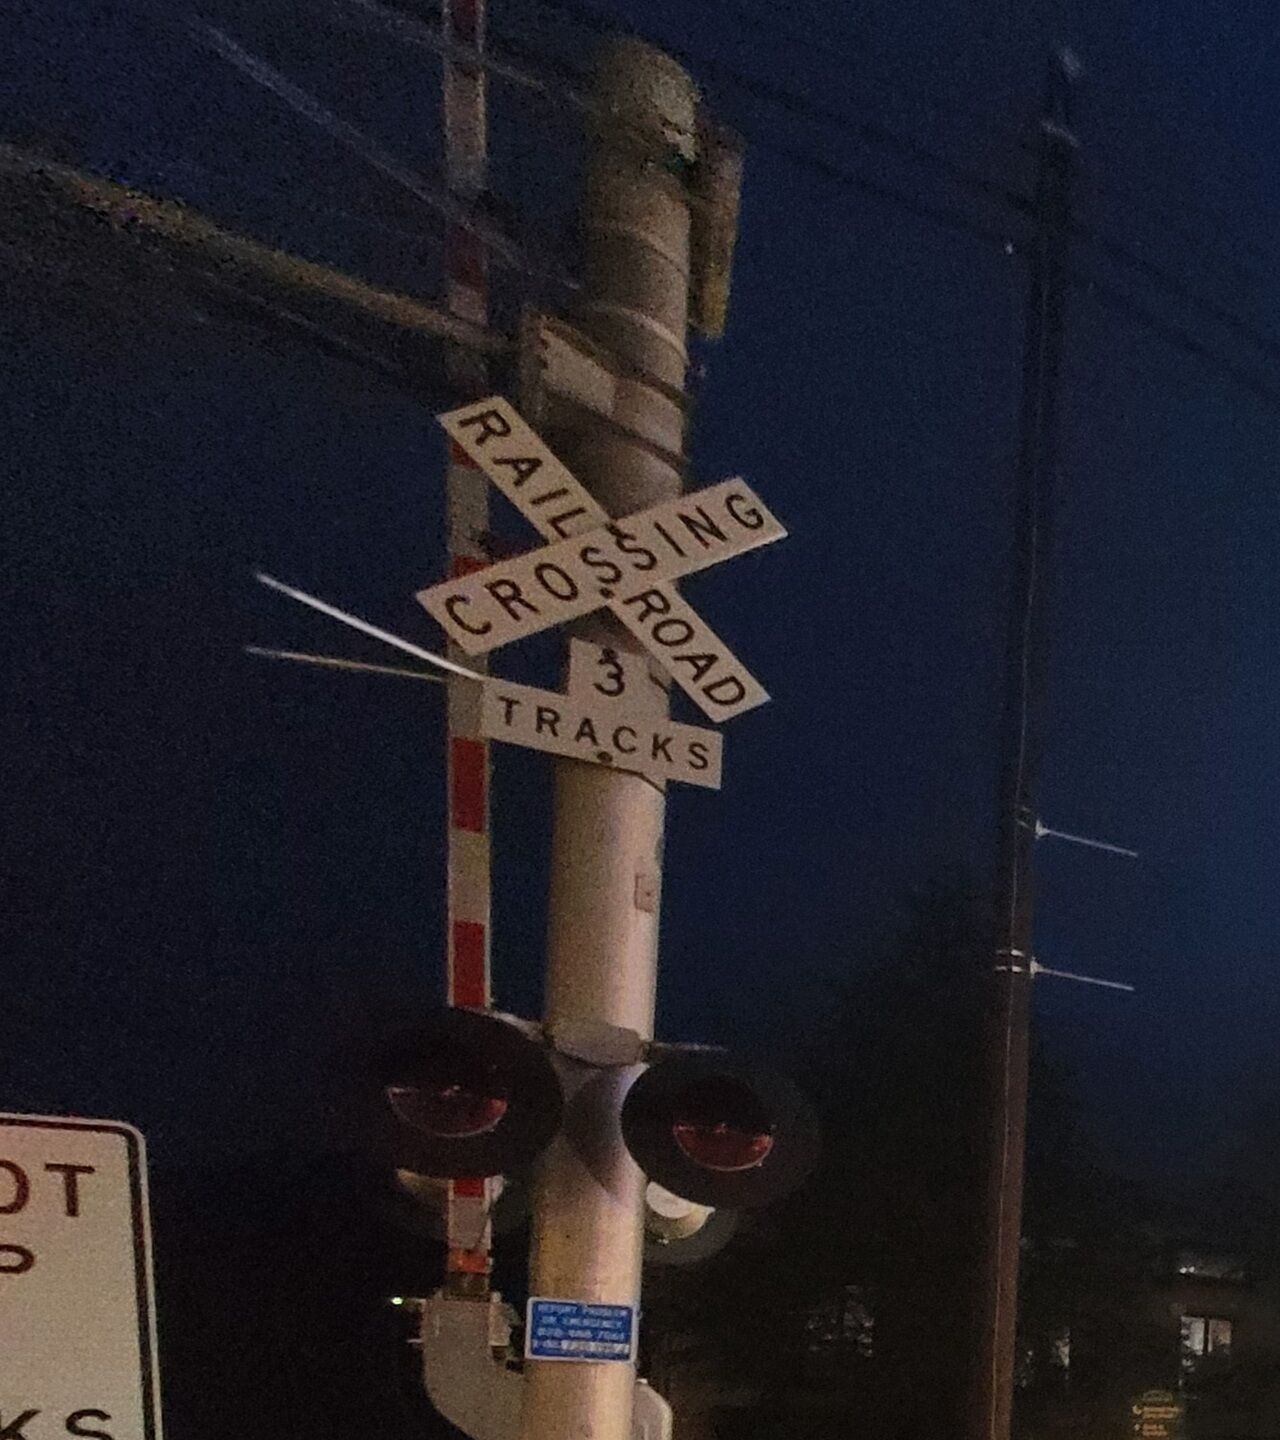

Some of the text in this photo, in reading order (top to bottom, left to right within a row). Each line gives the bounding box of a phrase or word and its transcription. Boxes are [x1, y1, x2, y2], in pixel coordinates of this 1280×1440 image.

[444, 493, 765, 636] CROSSING
[593, 655, 626, 697] 3
[497, 695, 710, 770] TRACKS
